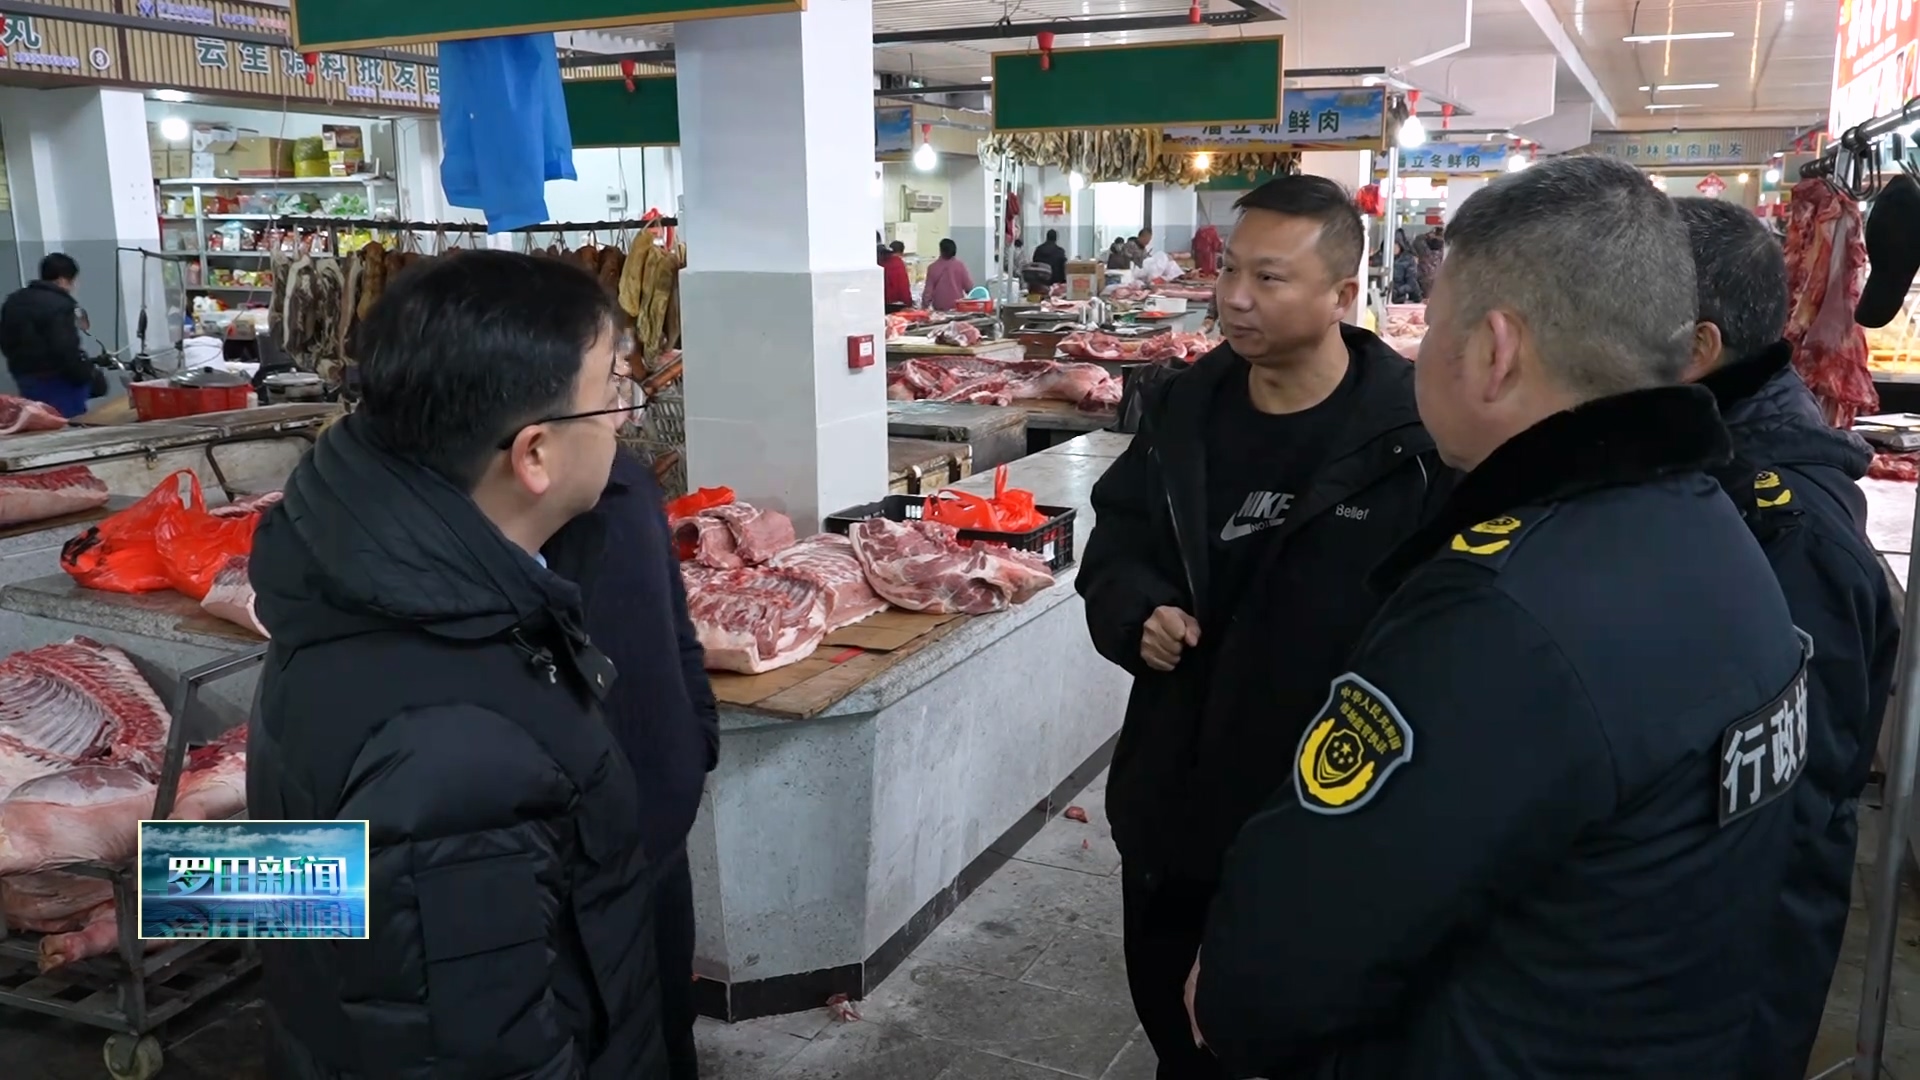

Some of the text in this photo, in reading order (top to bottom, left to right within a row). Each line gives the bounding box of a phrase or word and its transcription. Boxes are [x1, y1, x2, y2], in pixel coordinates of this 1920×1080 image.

[1237, 490, 1295, 519] NIKE
[1336, 503, 1370, 521] Belief
[1340, 686, 1402, 750] 中华人民共和国
